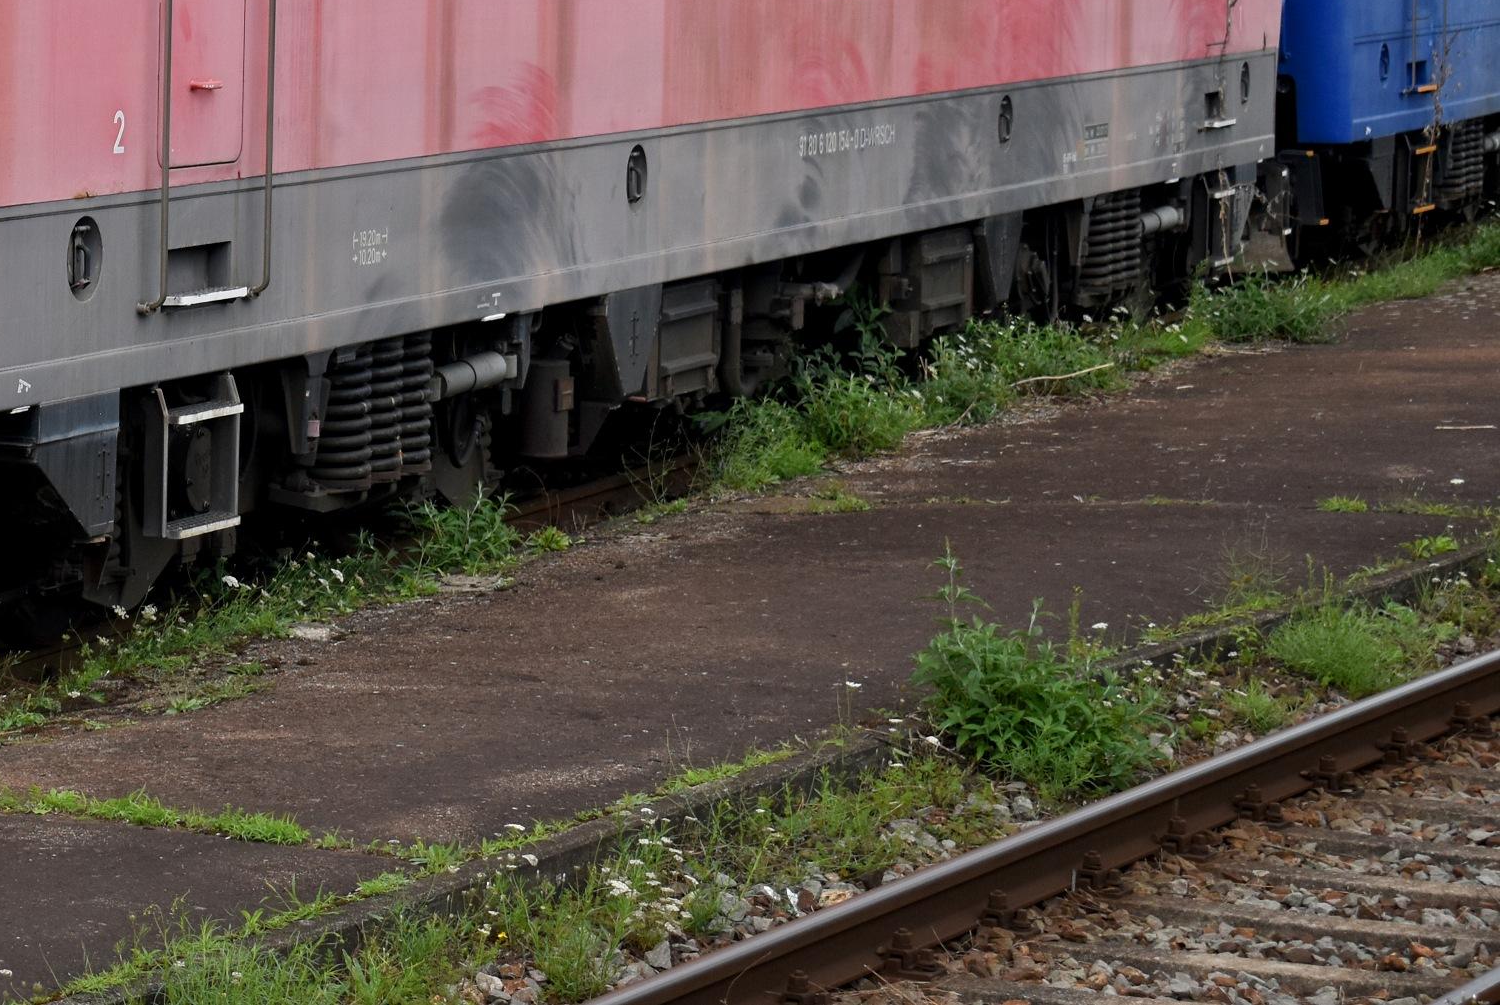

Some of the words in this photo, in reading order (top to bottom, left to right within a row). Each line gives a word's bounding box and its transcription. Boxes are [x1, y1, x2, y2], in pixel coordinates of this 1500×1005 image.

[113, 110, 125, 154] 2
[799, 135, 807, 157] 91
[808, 134, 818, 156] 80
[819, 133, 824, 155] 6
[826, 131, 838, 153] 120
